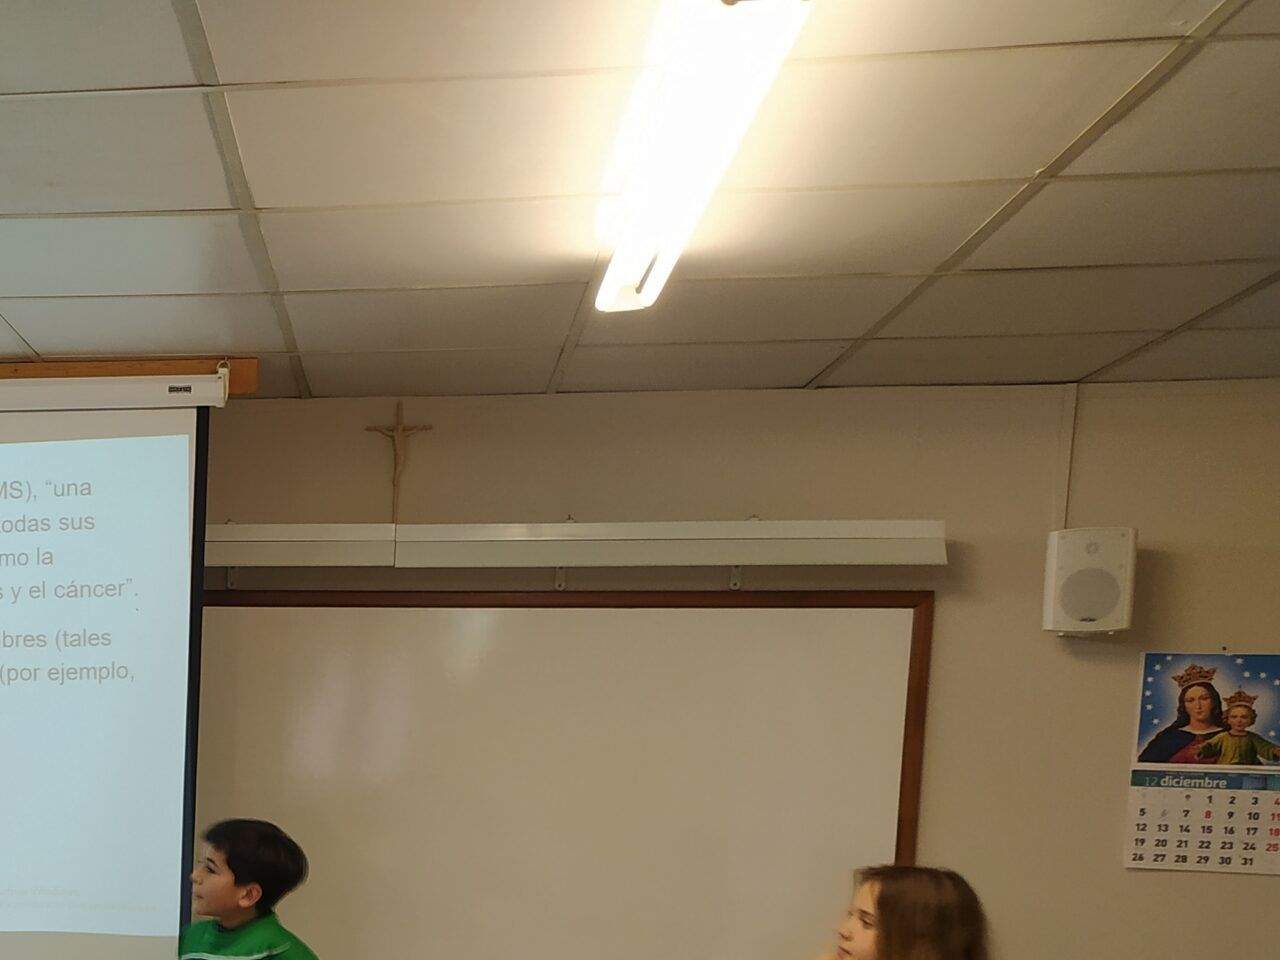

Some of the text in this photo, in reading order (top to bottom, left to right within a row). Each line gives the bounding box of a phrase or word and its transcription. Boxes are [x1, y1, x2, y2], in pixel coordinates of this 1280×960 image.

[57, 514, 96, 531] sus
[35, 547, 54, 567] la
[10, 585, 22, 605] y
[28, 582, 47, 599] el
[55, 628, 112, 649] (tales
[46, 661, 135, 686] ejemplo,
[1160, 776, 1227, 788] diciembre
[1208, 795, 1212, 803] 1
[1229, 796, 1236, 804] 2
[1252, 797, 1258, 805] 3
[1140, 808, 1146, 816] 5
[1205, 810, 1211, 818] 8
[1136, 823, 1147, 831] 12
[1157, 824, 1168, 832] 13
[1179, 825, 1190, 833] 14
[1269, 828, 1280, 836] 18
[1135, 838, 1145, 846] 19
[1155, 839, 1167, 847] 20
[1176, 840, 1188, 848] 21
[1198, 841, 1211, 849] 22
[1221, 842, 1233, 850] 23
[1132, 853, 1144, 861] 26
[1153, 854, 1166, 862] 27
[1175, 855, 1187, 863] 28
[1196, 856, 1209, 864] 29
[1219, 857, 1231, 865] 30
